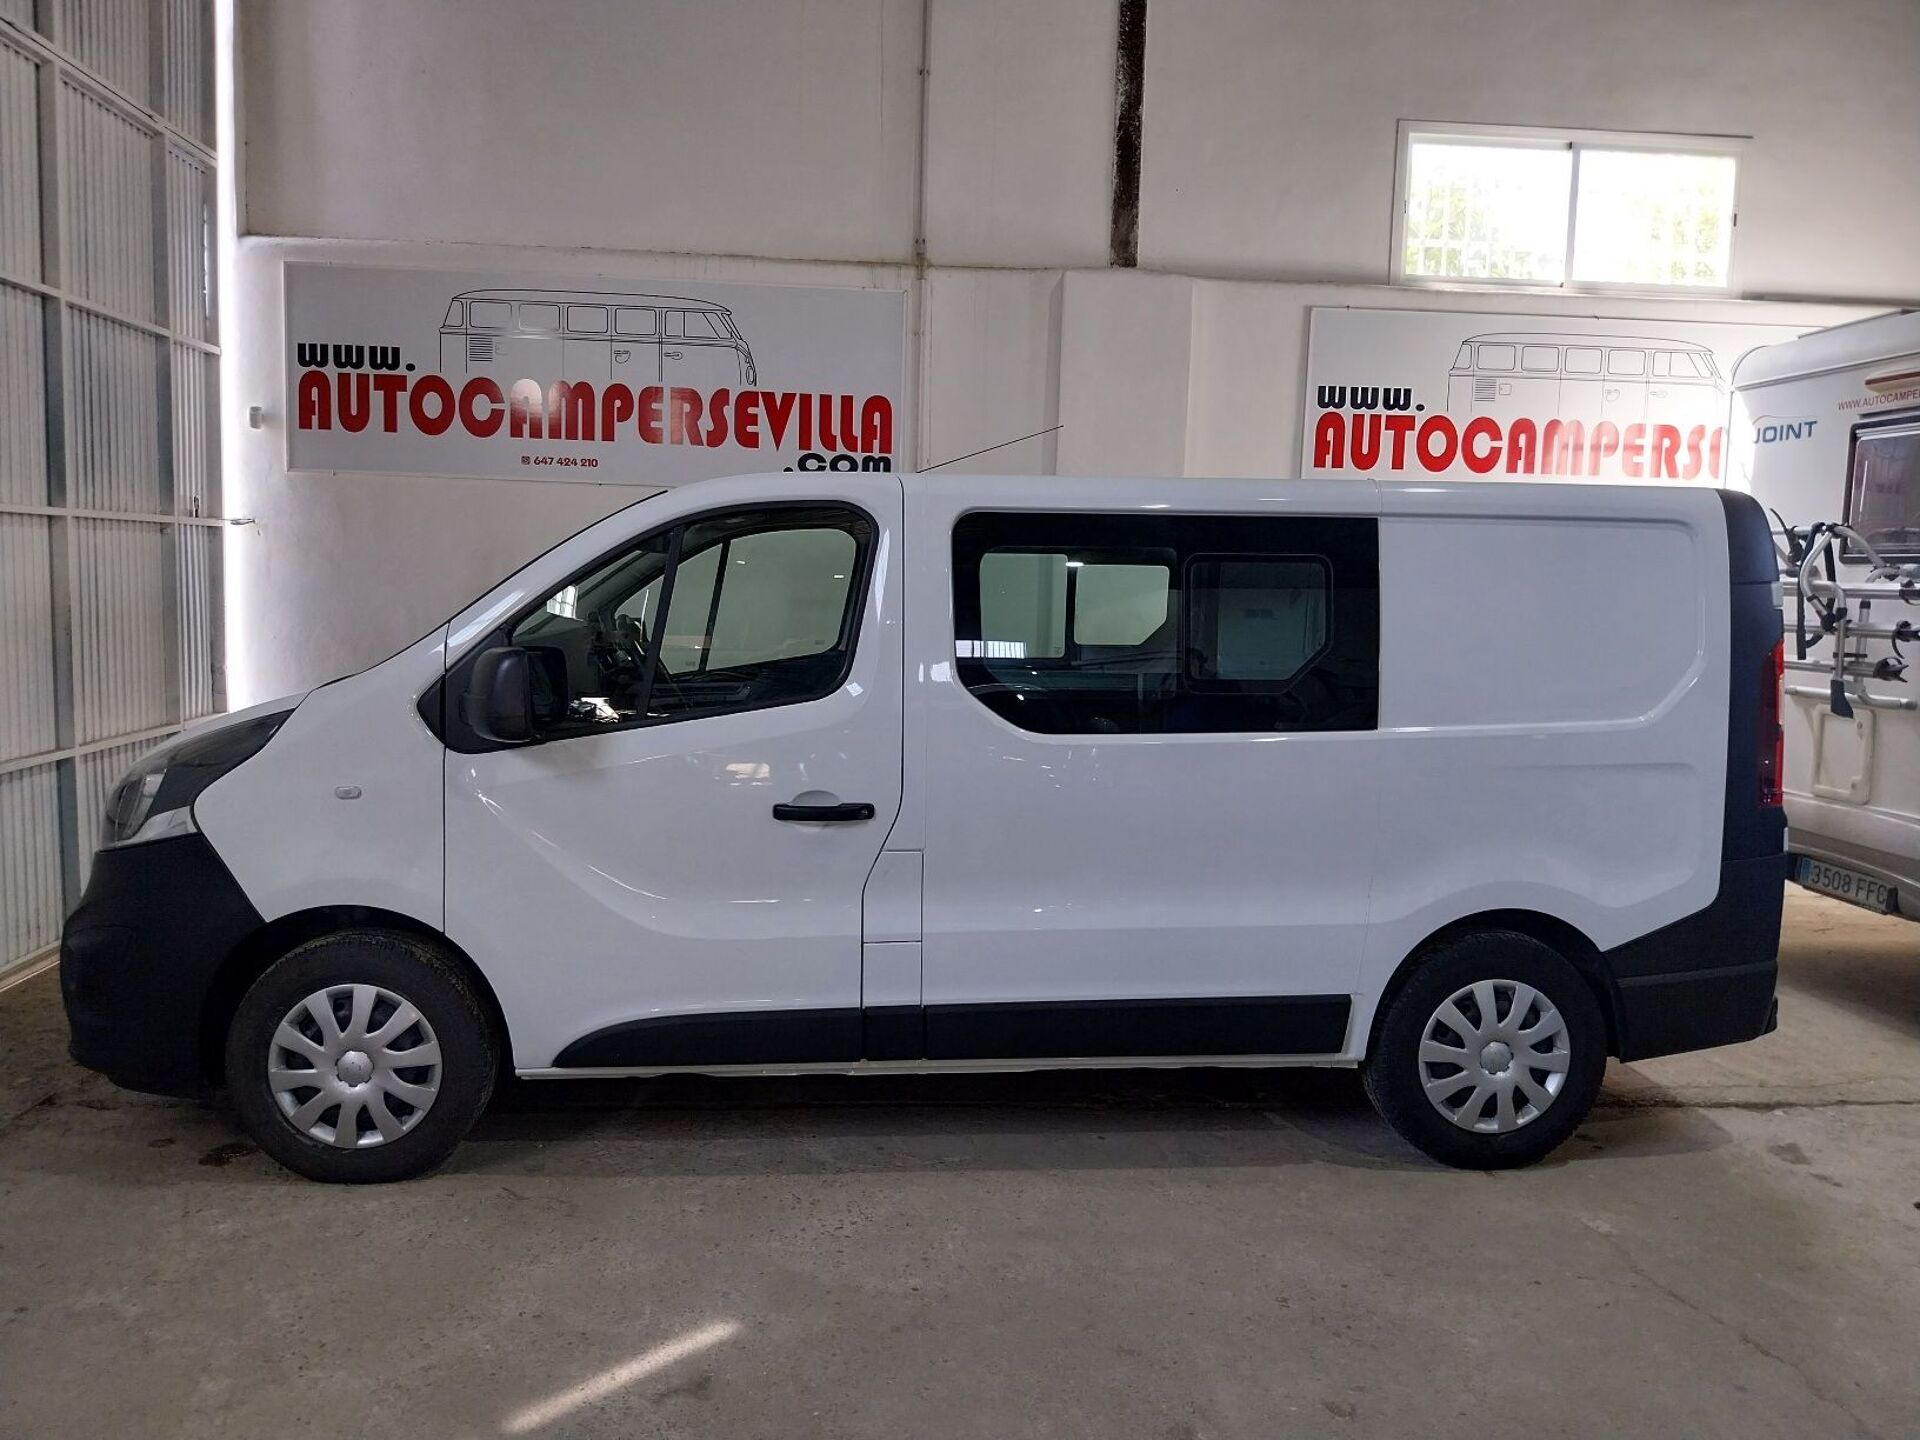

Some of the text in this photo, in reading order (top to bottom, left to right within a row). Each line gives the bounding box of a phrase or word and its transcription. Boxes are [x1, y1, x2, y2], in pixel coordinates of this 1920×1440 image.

[297, 343, 416, 372] www.
[298, 370, 893, 454] AUTOCAMPERSEVILLA
[1317, 385, 1425, 412] www.
[1837, 388, 1920, 411] WWW.AUTOCAMPE
[1753, 420, 1818, 444] JOINT
[533, 456, 599, 468] 647 424 210
[1811, 865, 1852, 894] 3508
